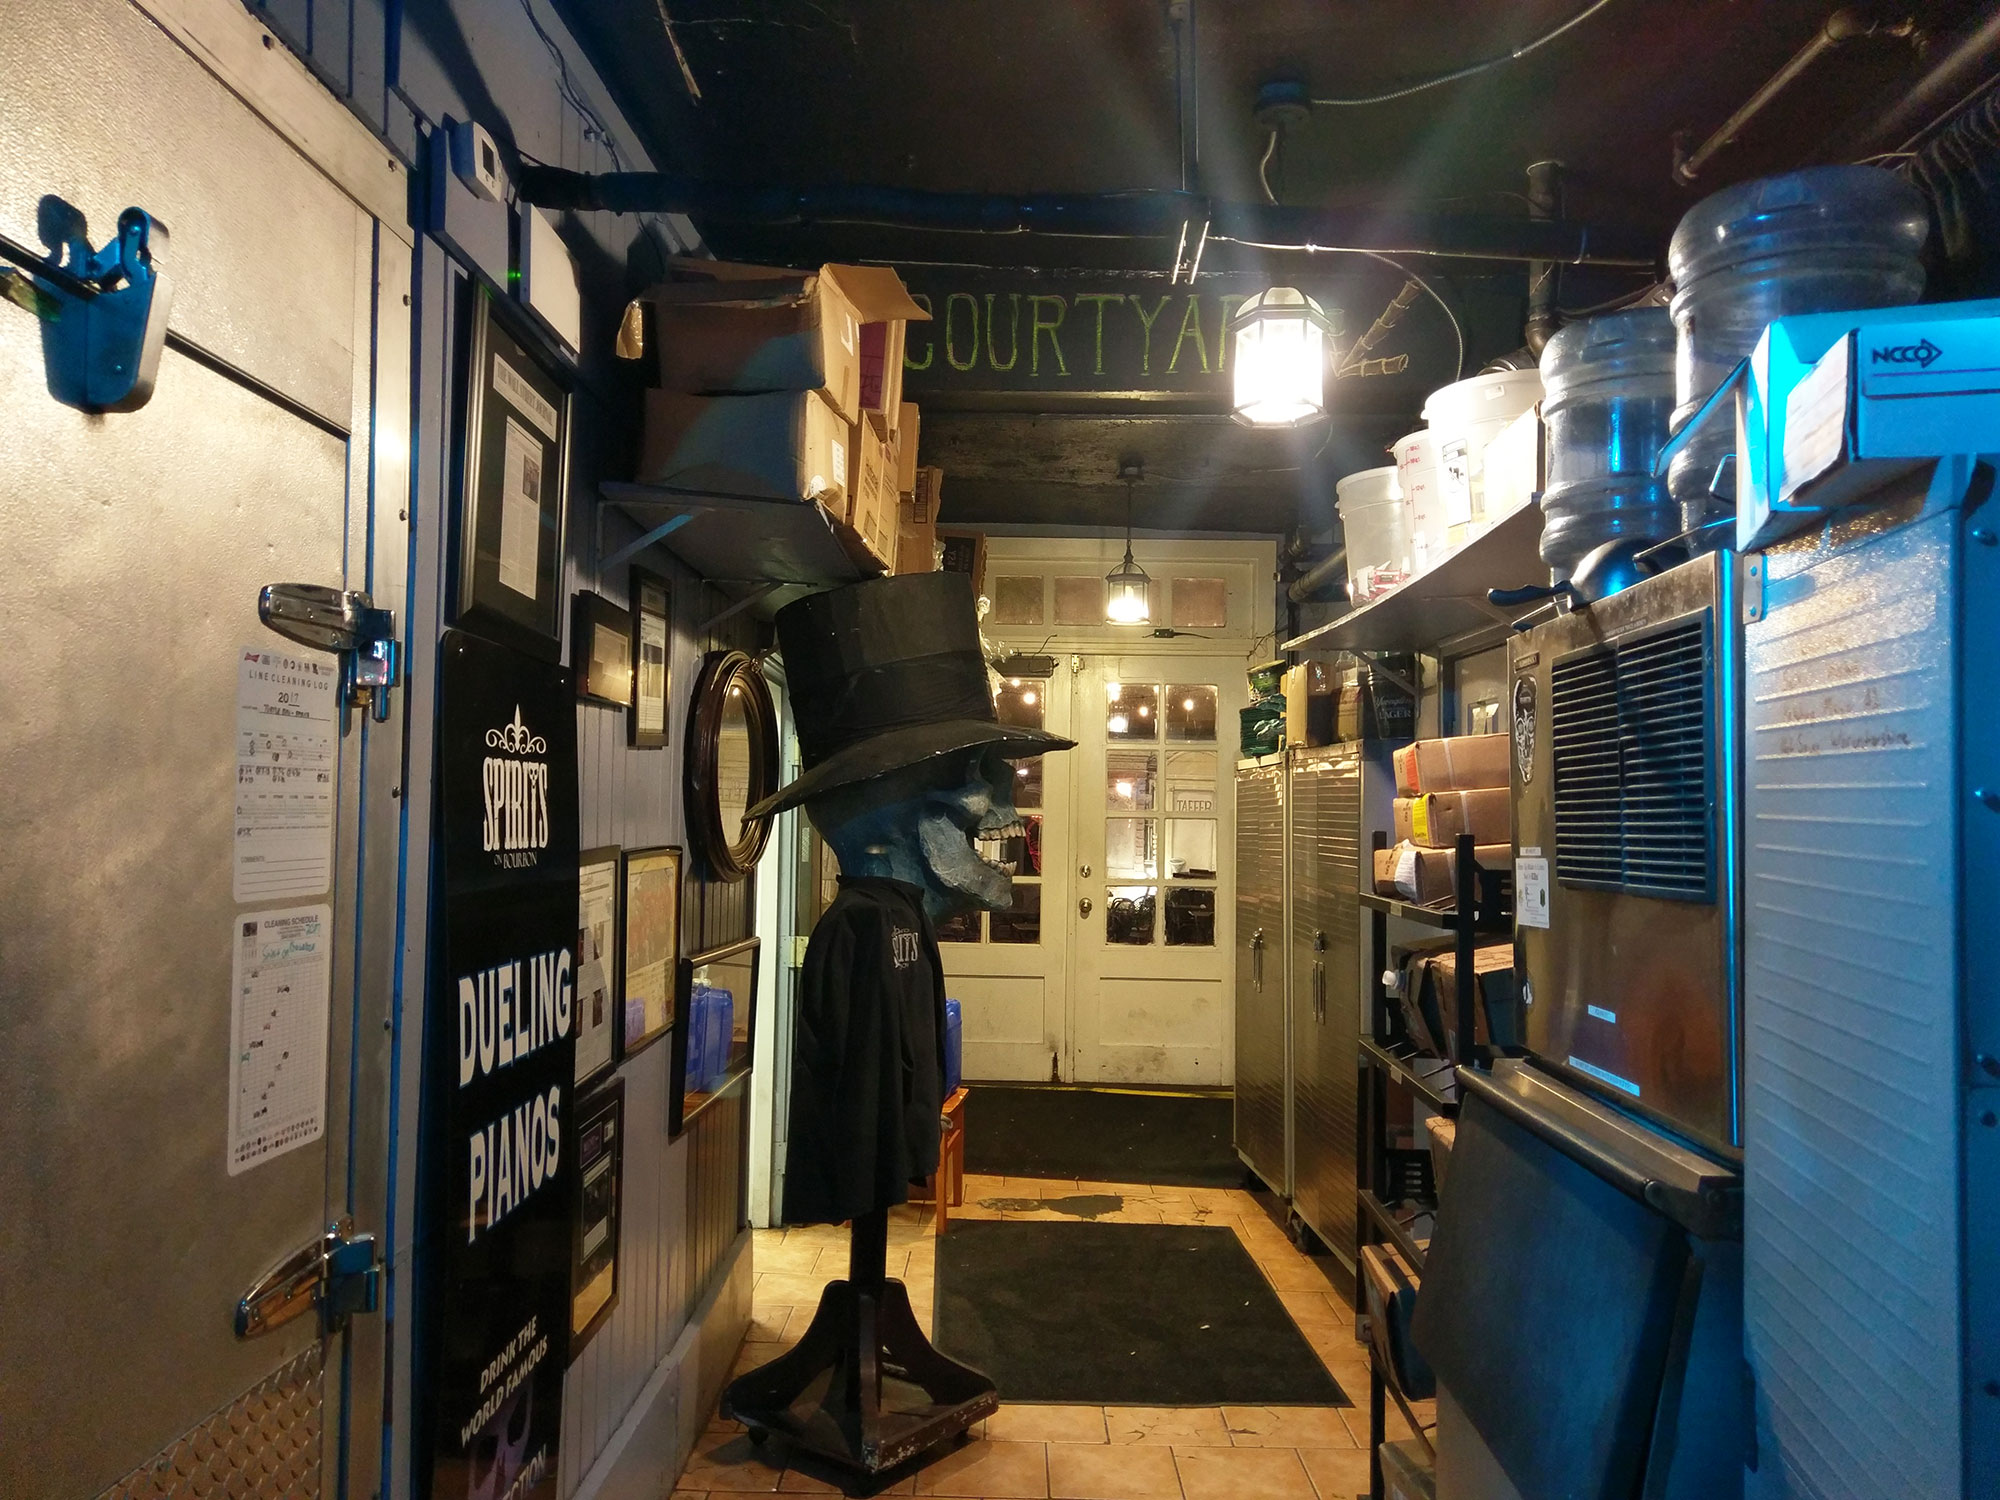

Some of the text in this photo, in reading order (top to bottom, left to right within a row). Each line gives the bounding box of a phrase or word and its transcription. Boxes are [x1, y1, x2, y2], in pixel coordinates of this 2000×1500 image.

[249, 669, 329, 691] LINE CLEANING LOG
[1379, 709, 1411, 720] LAGER
[483, 757, 549, 852] SPIRITS
[503, 851, 538, 869] BOURBON
[263, 915, 319, 929] CLEANING SCHEDULE
[457, 947, 572, 1090] DUELING
[467, 1083, 561, 1245] PIANOS
[461, 1334, 548, 1449] WORLD FAMOUS
[480, 1314, 538, 1395] DRINK THE
